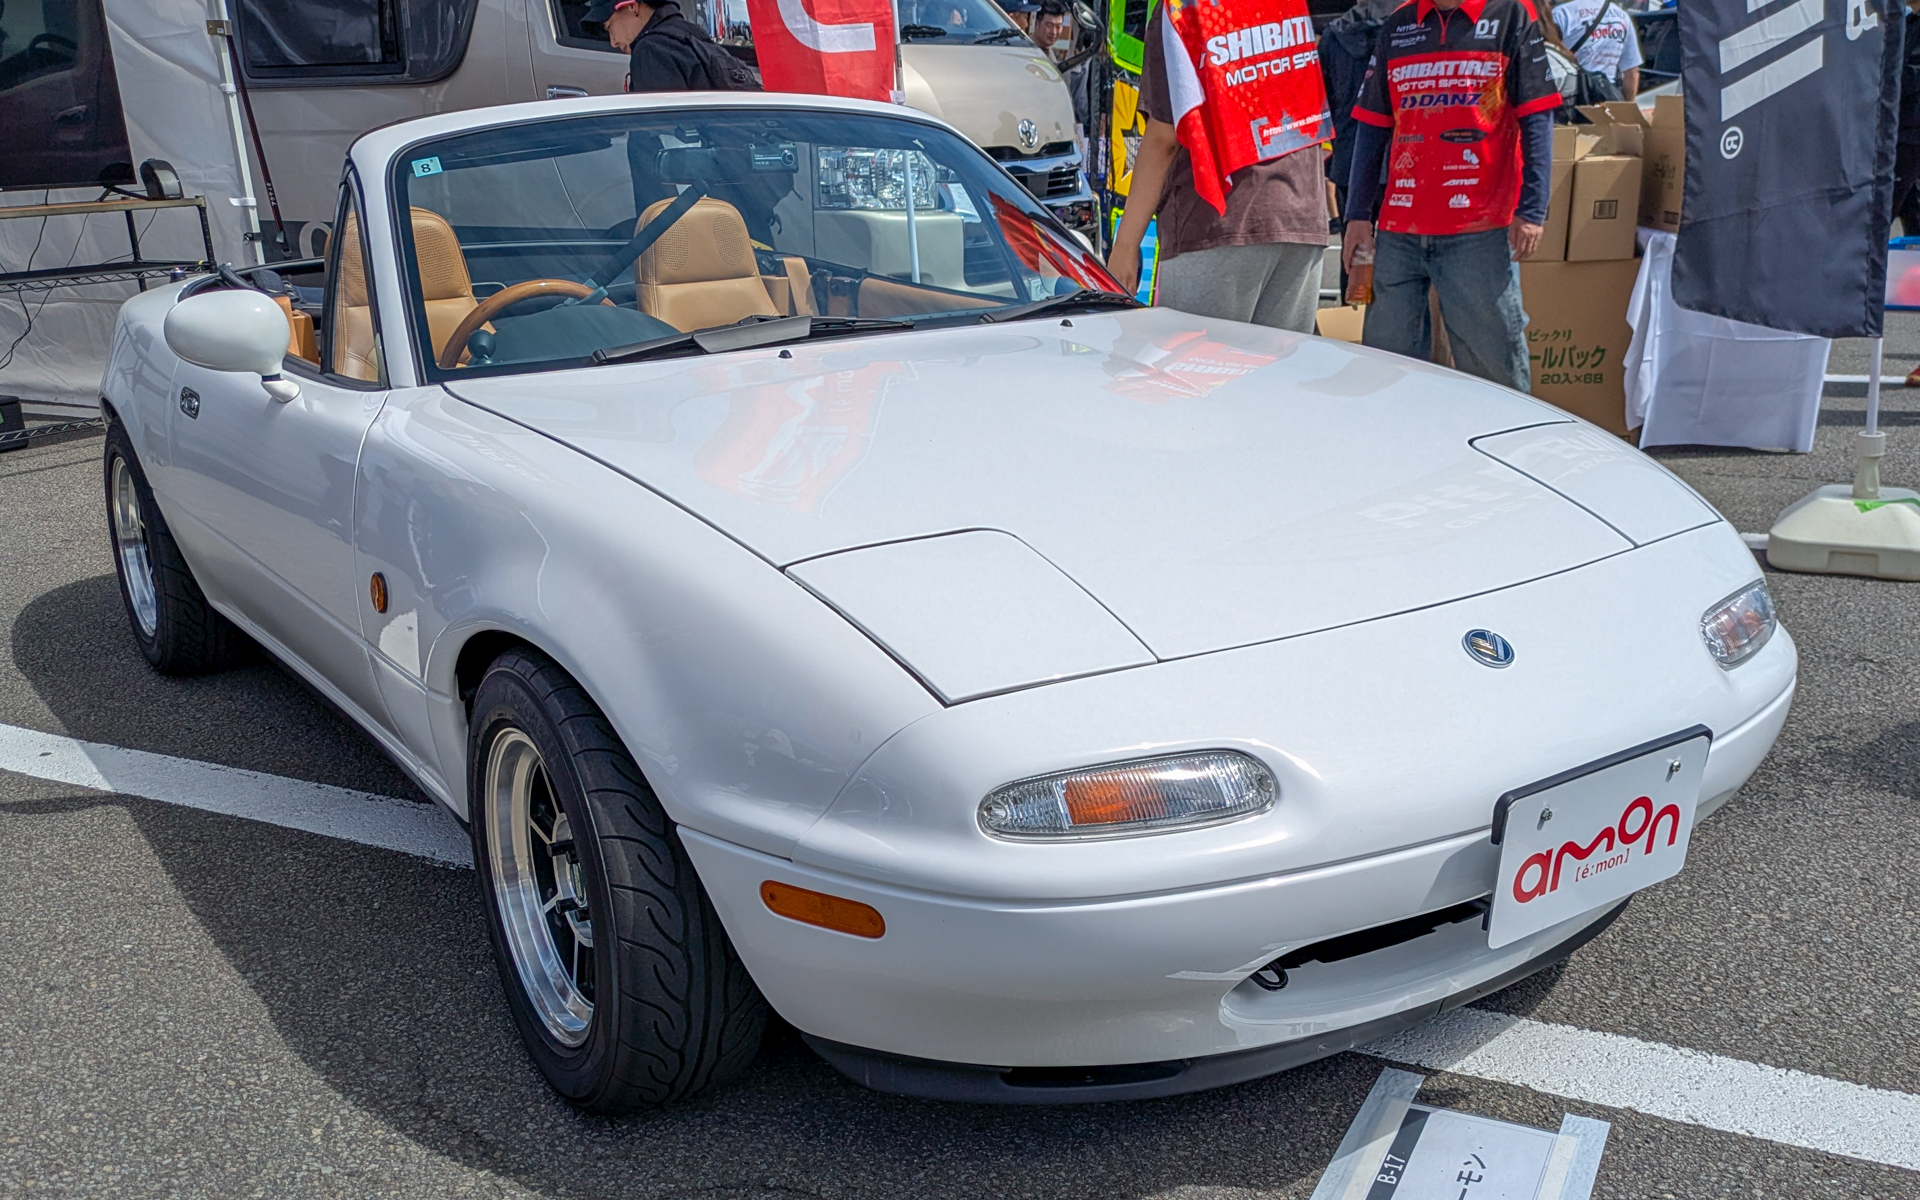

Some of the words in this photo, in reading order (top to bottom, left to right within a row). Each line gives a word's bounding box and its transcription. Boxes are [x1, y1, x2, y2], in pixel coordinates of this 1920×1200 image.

[1579, 7, 1625, 19] ENGAND
[1475, 19, 1500, 35] D1
[1225, 56, 1291, 87] MOTOR
[1391, 60, 1499, 83] SHIBATIRE
[1397, 80, 1436, 92] MOTOR
[1438, 79, 1486, 88] SPORT
[1529, 329, 1572, 342] ビックリ
[1513, 796, 1680, 904] amon
[1377, 1153, 1406, 1185] B-17
